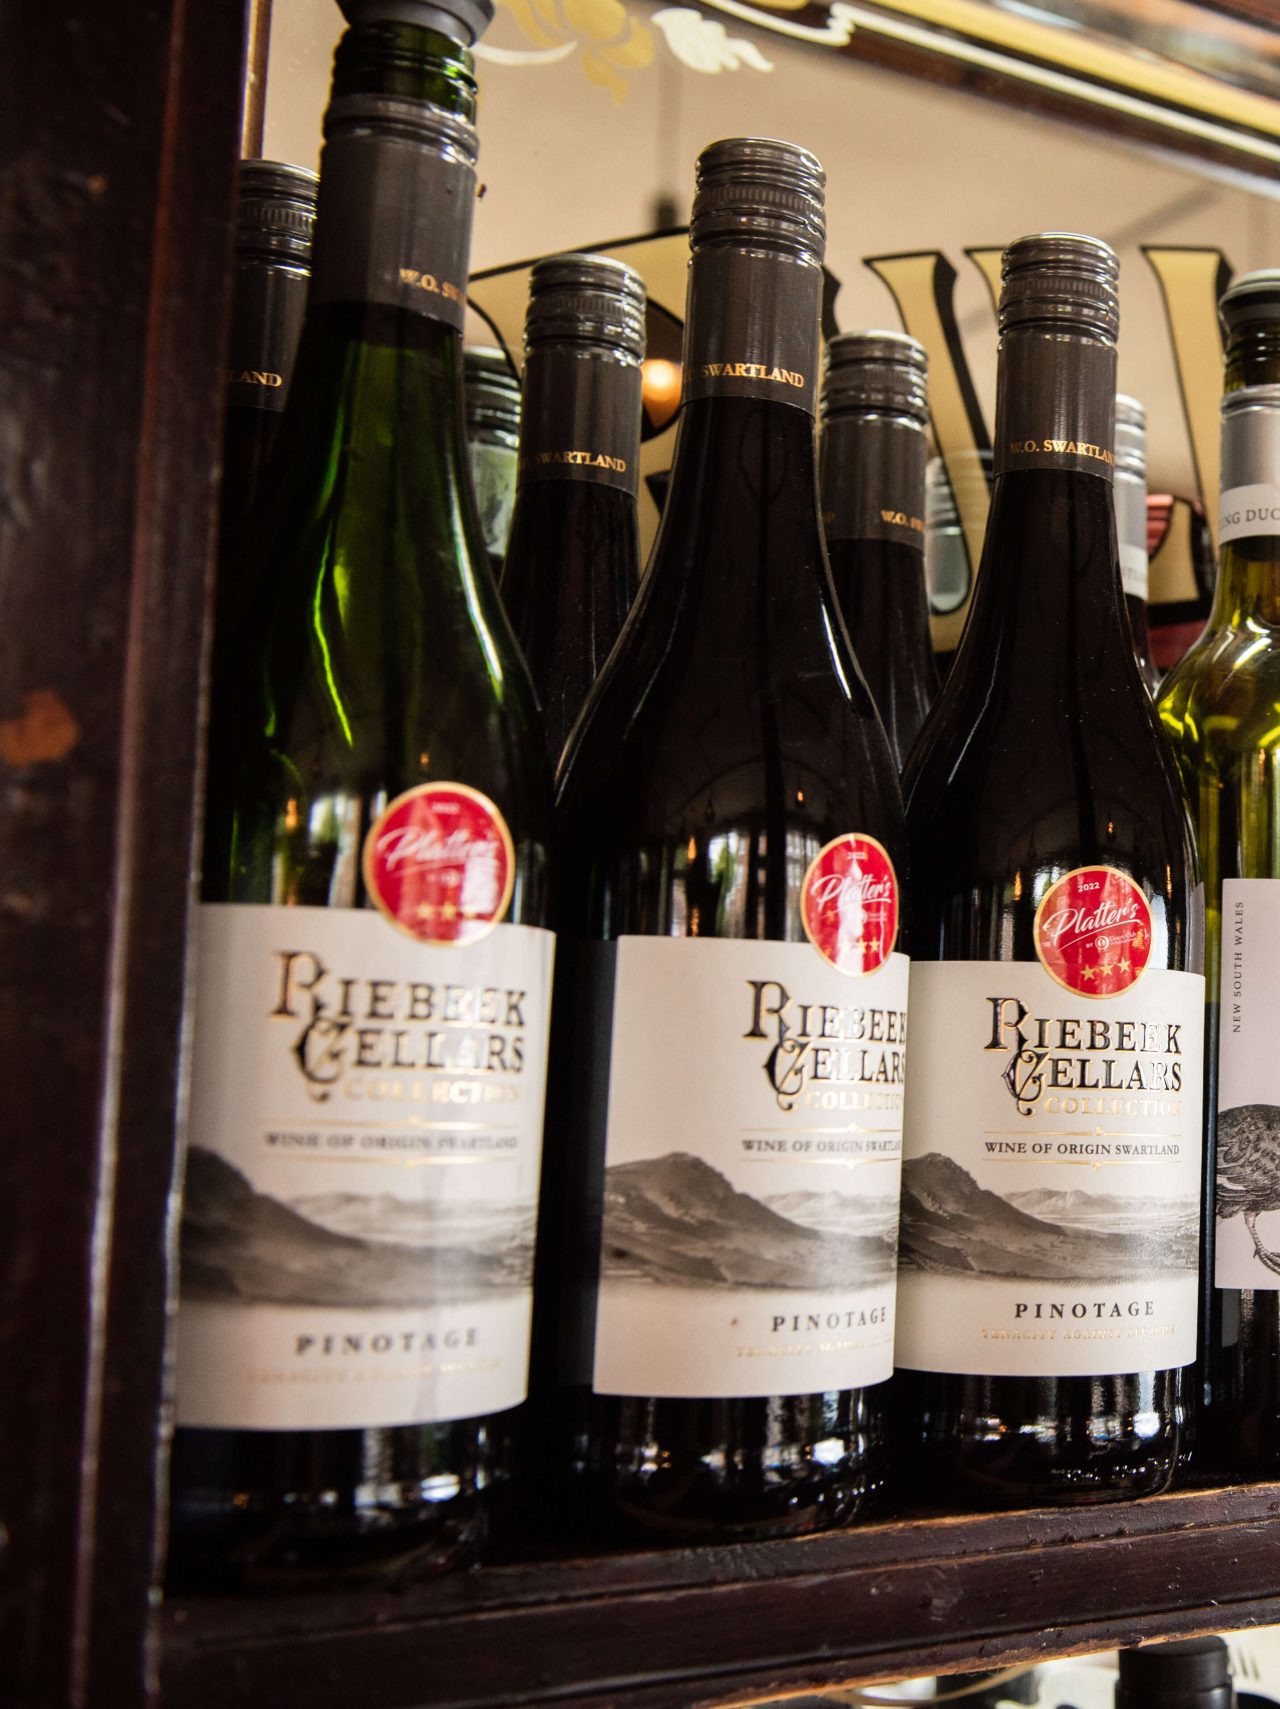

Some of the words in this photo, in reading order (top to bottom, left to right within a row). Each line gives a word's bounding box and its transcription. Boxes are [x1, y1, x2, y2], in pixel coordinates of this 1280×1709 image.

[702, 362, 805, 389] SWARTLAND
[1043, 439, 1115, 466] SWARTLAN
[1077, 881, 1101, 894] 2022
[1042, 897, 1141, 947] Platter's
[1234, 901, 1244, 946] WALES
[269, 949, 527, 1026] RIEBEEK
[1233, 951, 1243, 998] SOUTH
[982, 996, 1183, 1055] RIEBEEK
[1232, 1003, 1242, 1033] NEW
[290, 1017, 525, 1102] CELLARS
[1000, 1049, 1183, 1116] CELLARS
[1044, 1096, 1182, 1116] COLLECTION
[741, 1139, 788, 1152] WINE
[792, 1140, 813, 1152] OF
[816, 1141, 863, 1153] ORIGIN
[984, 1141, 1027, 1154] WINE
[1032, 1142, 1053, 1154] OF
[1056, 1143, 1112, 1155] ORIGIN
[1115, 1144, 1181, 1156] SWARTLAND
[771, 1306, 888, 1333] PINOTAGE
[1014, 1300, 1155, 1319] PINOTAGE
[295, 1327, 480, 1356] PINOTAGE
